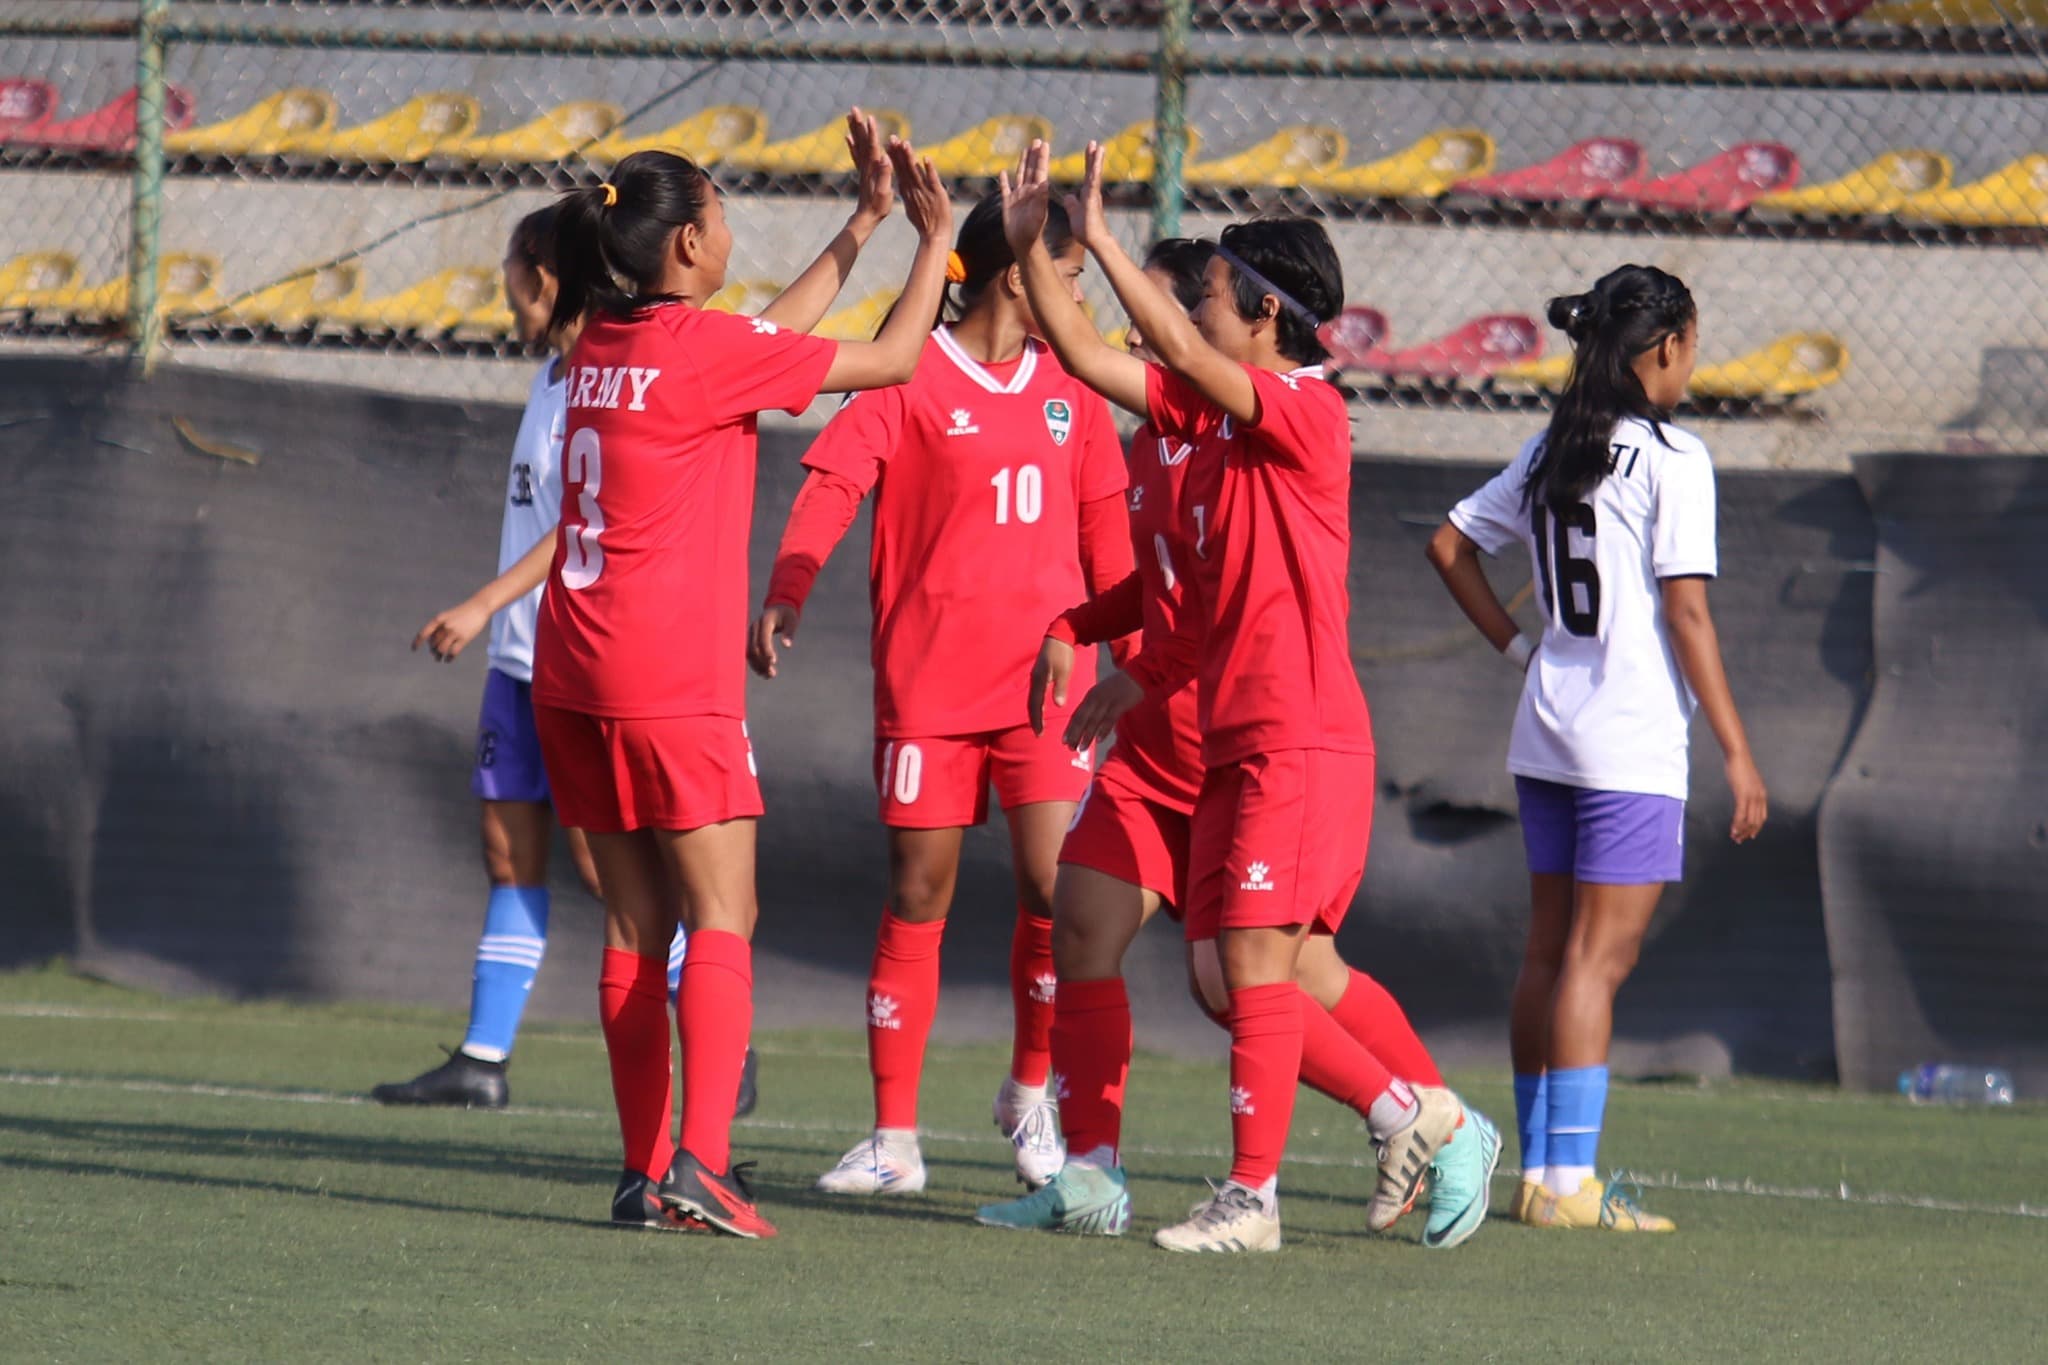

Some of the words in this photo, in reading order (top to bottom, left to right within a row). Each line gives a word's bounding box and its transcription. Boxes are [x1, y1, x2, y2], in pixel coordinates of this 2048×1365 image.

[560, 427, 605, 591] 3
[991, 464, 1042, 524] 10
[1531, 502, 1601, 637] 16
[882, 742, 922, 804] 10
